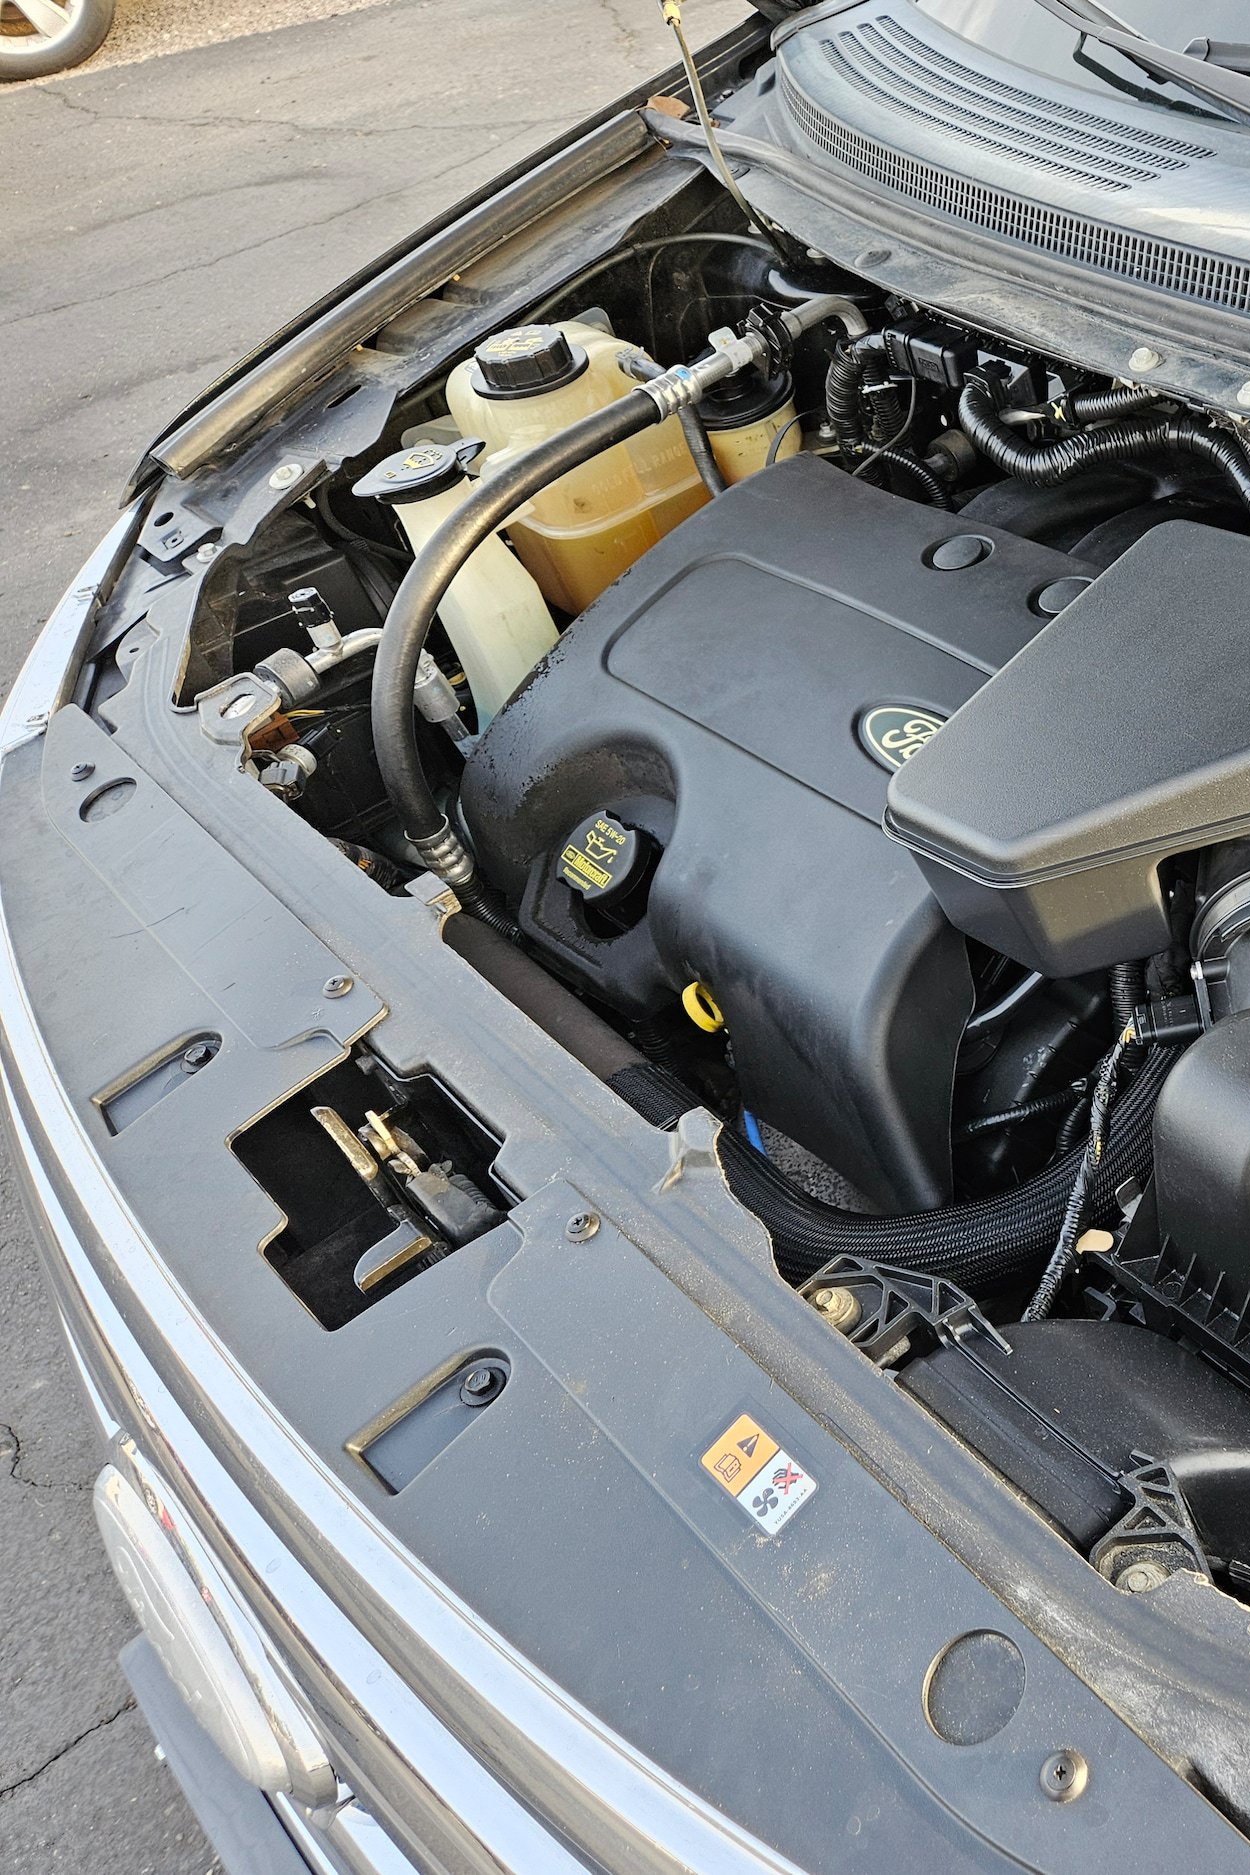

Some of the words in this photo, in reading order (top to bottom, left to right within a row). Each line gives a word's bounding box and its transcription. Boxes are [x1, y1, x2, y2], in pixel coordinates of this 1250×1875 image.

[595, 819, 609, 833] SAE
[606, 825, 626, 845] 5W-20
[573, 854, 608, 885] Motorcraft
